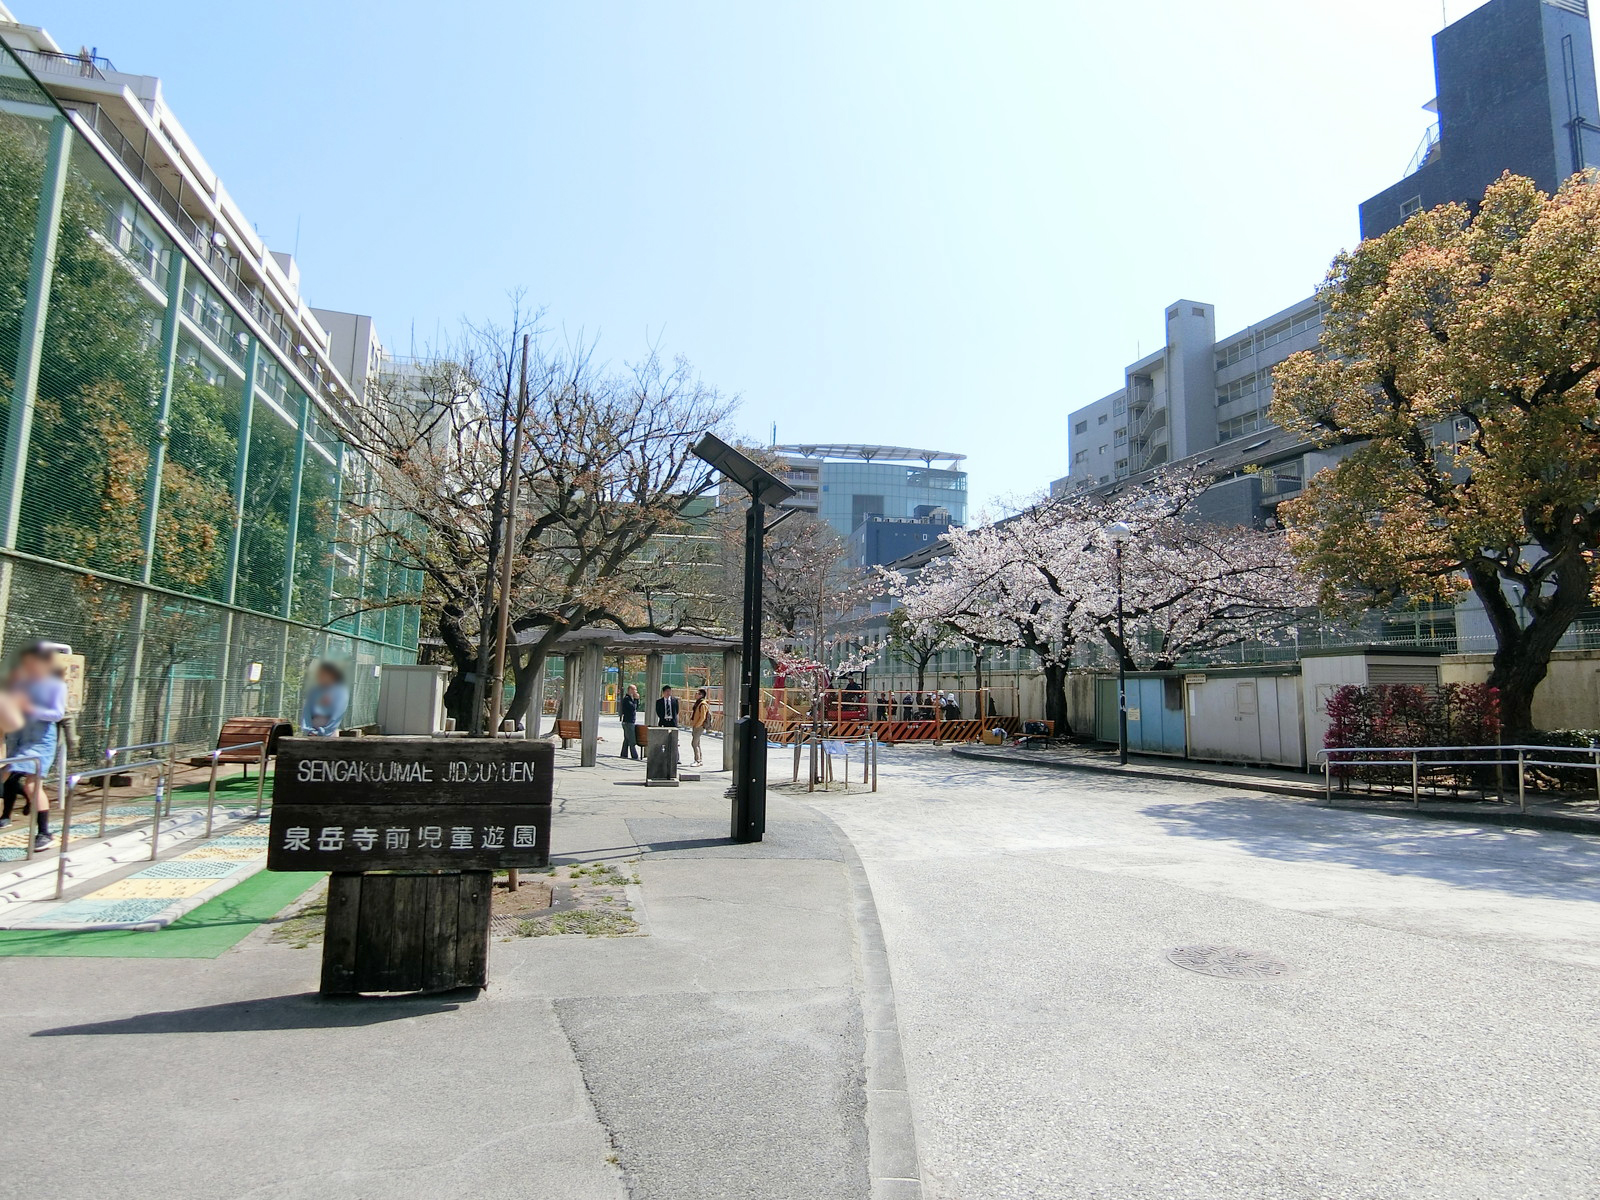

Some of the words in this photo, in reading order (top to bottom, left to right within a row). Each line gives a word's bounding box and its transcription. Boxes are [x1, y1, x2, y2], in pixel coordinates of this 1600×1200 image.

[283, 825, 536, 851] 泉岳寺前児童遊園
